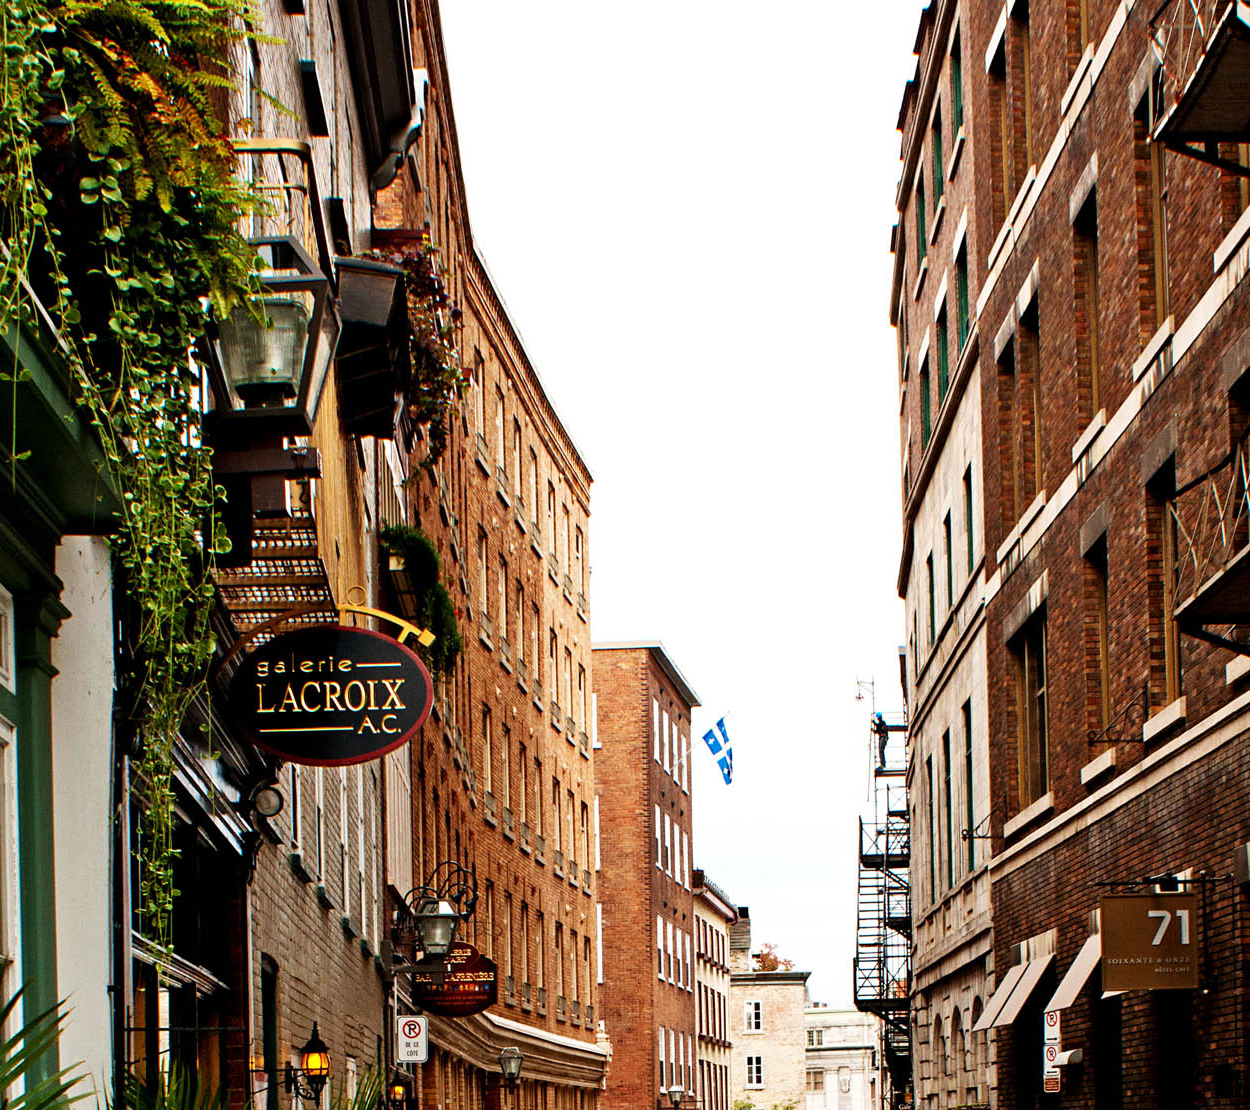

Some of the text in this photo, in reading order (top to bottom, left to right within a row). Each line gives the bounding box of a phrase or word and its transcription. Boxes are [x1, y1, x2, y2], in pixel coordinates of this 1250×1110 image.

[256, 652, 353, 677] galerie
[256, 679, 406, 713] LACROIX
[357, 713, 402, 735] A.C.
[1147, 909, 1190, 946] 71
[1107, 957, 1153, 965] SOIXANTE
